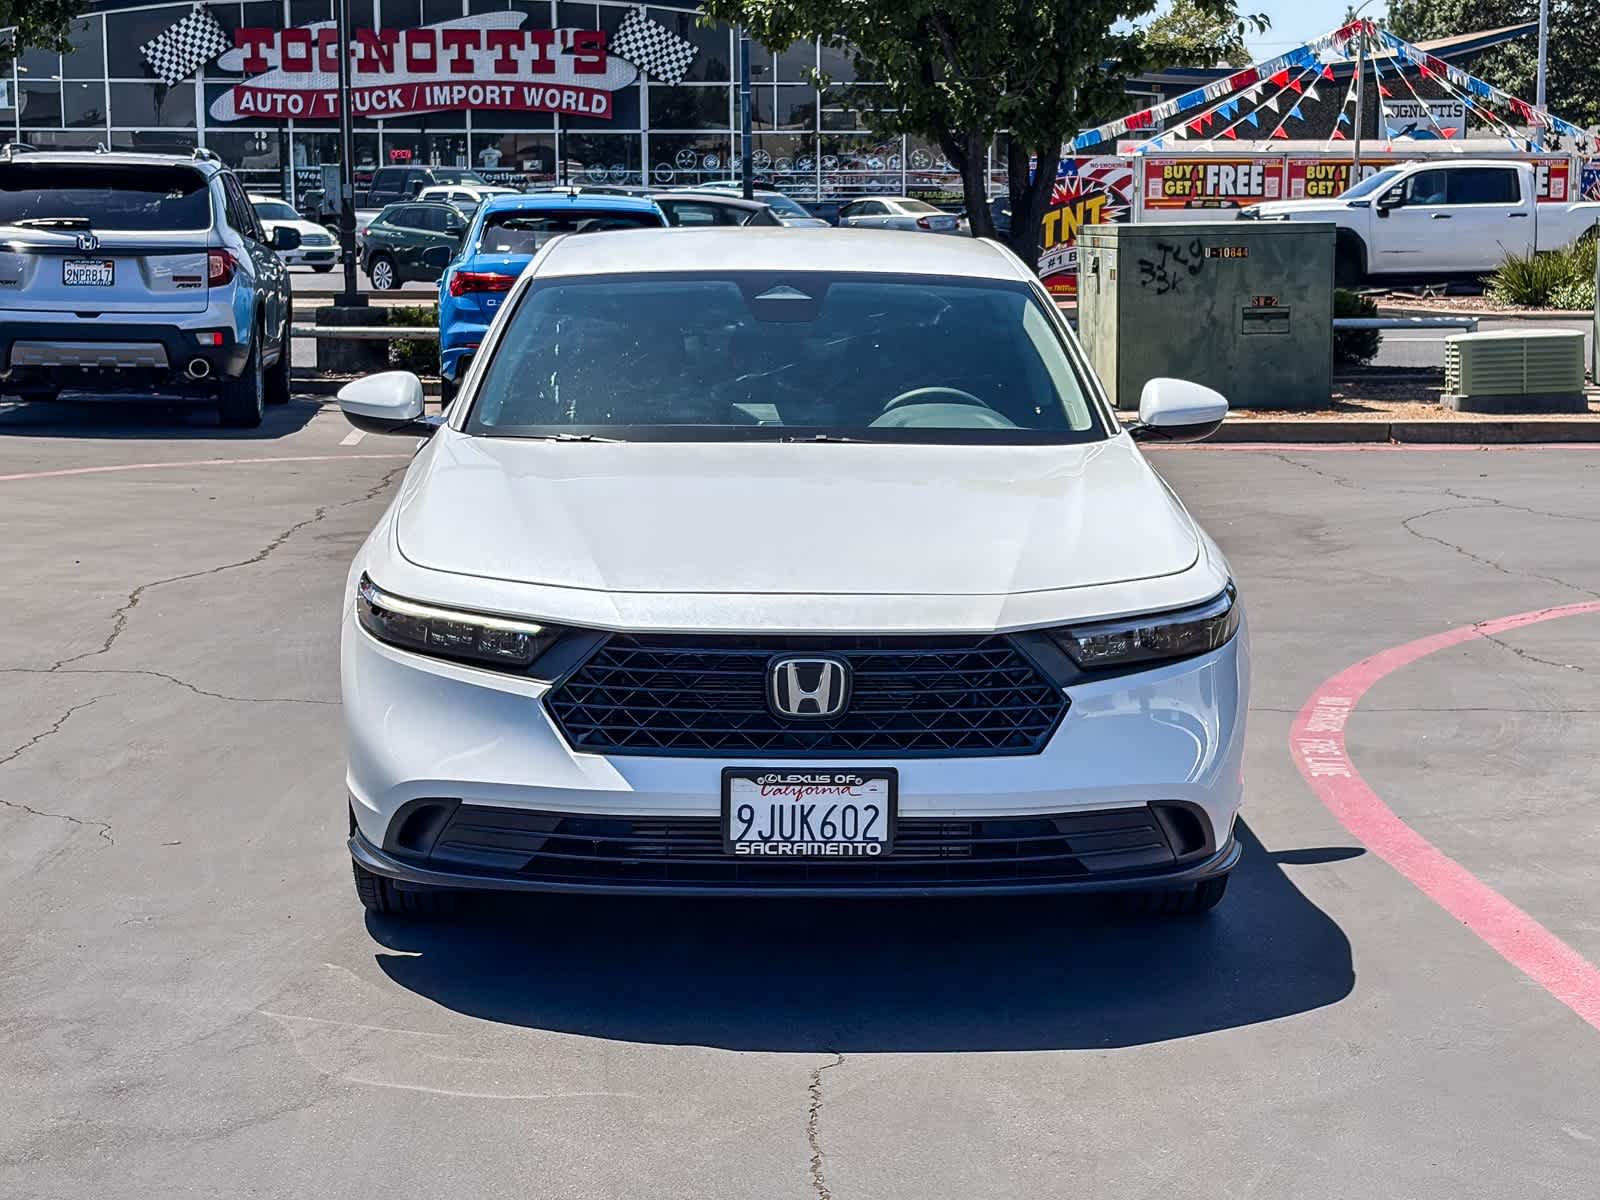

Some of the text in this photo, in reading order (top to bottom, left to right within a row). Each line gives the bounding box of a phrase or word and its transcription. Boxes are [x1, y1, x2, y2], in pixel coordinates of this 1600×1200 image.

[234, 27, 607, 75] TOGNOTTI'S
[239, 90, 304, 113] AUTO
[324, 88, 405, 113] TUCK
[425, 85, 515, 106] IMPORT
[523, 87, 608, 114] WORLD
[1163, 165, 1204, 179] BUY 1
[1306, 165, 1336, 180] BUY
[1341, 165, 1347, 180] 1
[1206, 165, 1264, 195] FREE
[1164, 181, 1192, 195] GET
[1196, 181, 1202, 194] 1
[1307, 181, 1335, 195] GET
[1042, 195, 1107, 249] TNT
[1047, 253, 1063, 268] #1
[66, 269, 111, 282] 9NPR817
[778, 774, 857, 784] LEXUS OF
[760, 784, 863, 802] California
[736, 803, 881, 842] 9JUK602
[735, 842, 882, 856] SACRAMENTO
